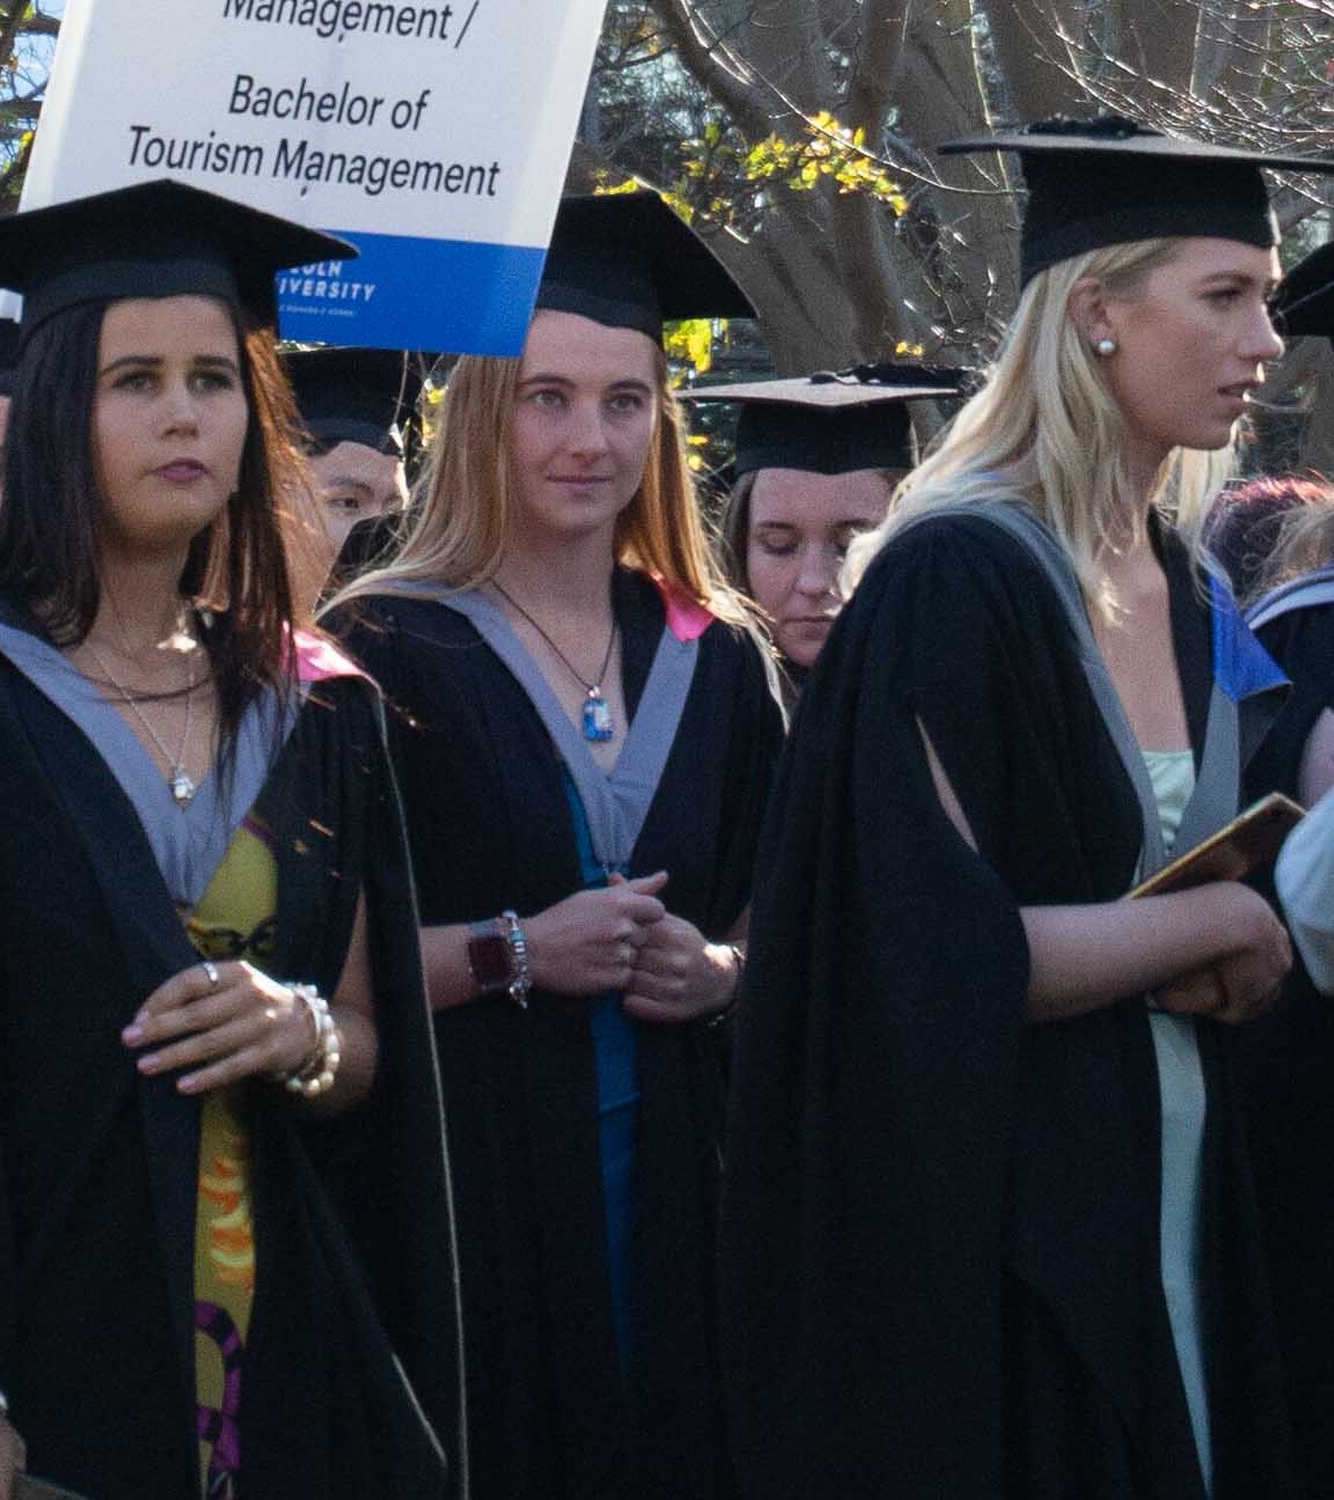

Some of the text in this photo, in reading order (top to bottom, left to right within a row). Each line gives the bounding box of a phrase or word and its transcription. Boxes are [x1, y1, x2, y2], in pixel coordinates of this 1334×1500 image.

[454, 0, 480, 49] /
[228, 73, 432, 132] Bachelor of
[128, 124, 502, 198] Tourism Management
[275, 276, 377, 302] IVERSITY
